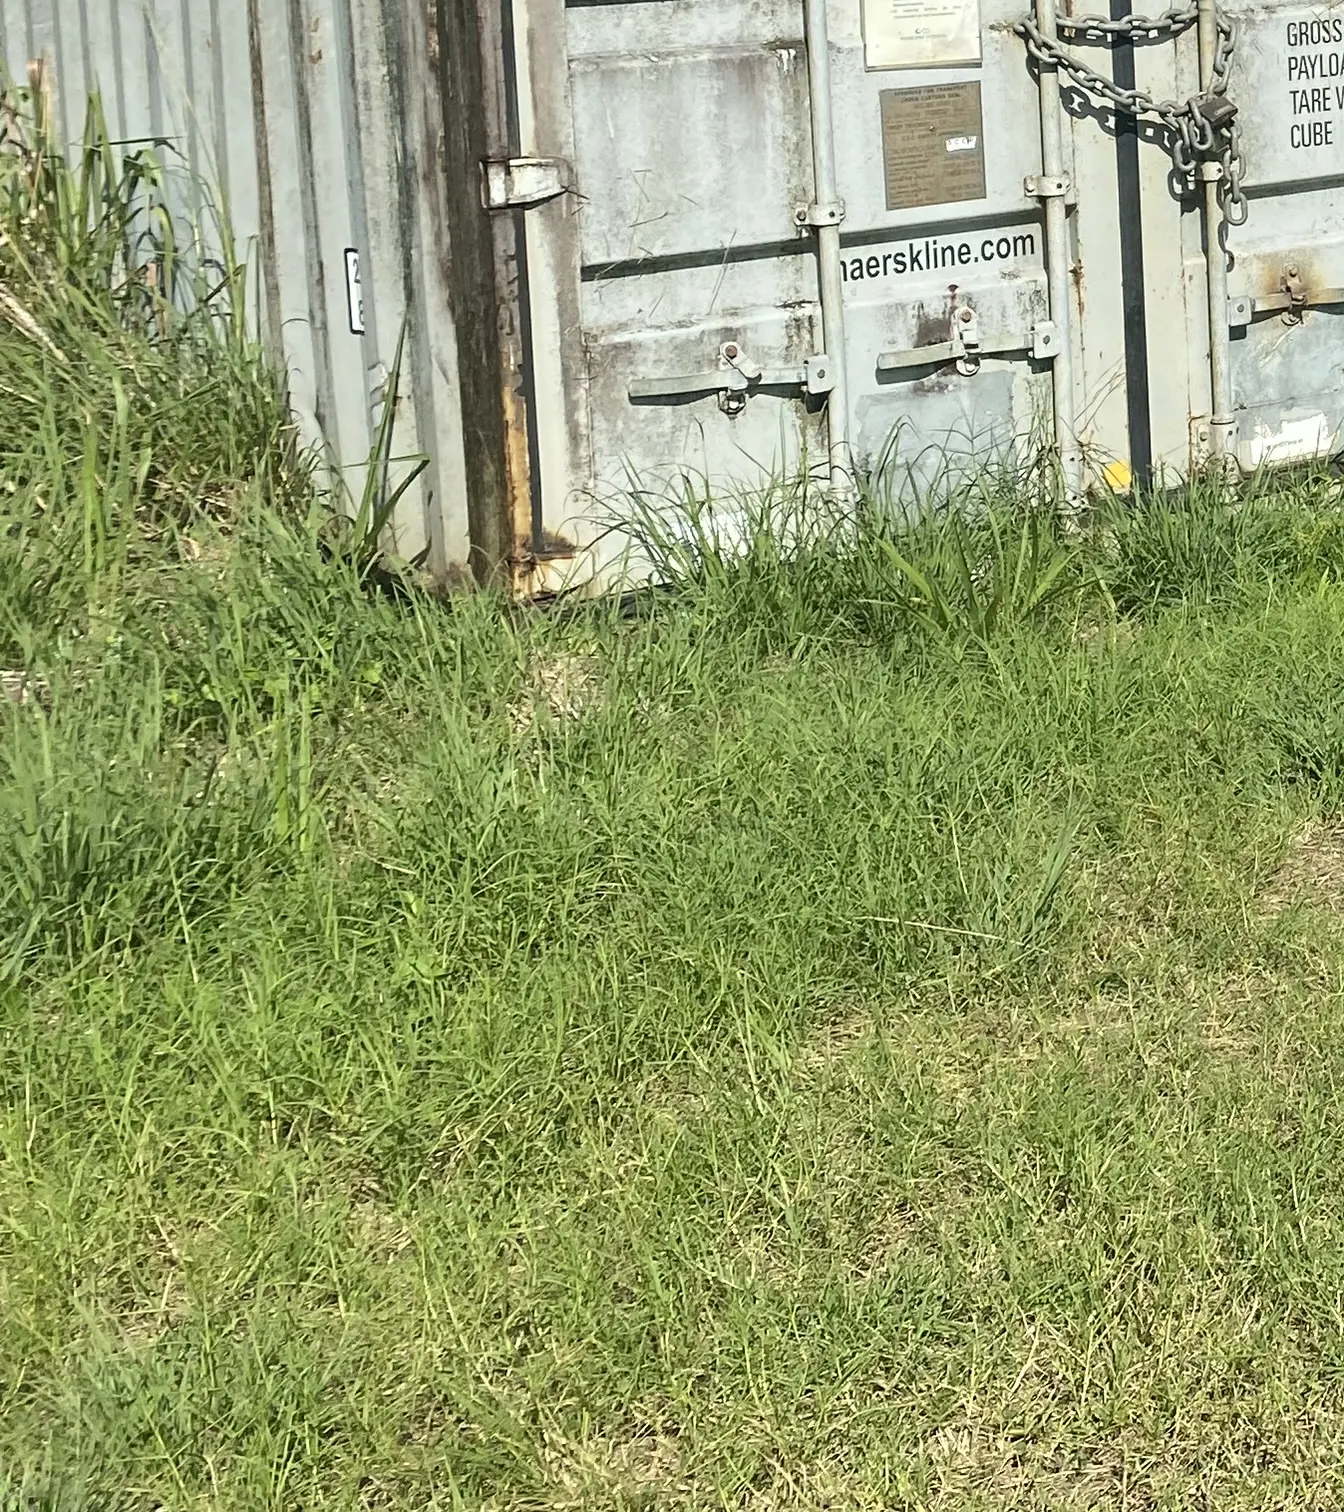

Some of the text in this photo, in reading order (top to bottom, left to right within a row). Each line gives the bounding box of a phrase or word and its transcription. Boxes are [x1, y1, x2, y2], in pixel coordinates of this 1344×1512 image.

[1287, 18, 1343, 46] GROSS
[1289, 86, 1331, 115] TARE
[1290, 120, 1333, 149] CUBE
